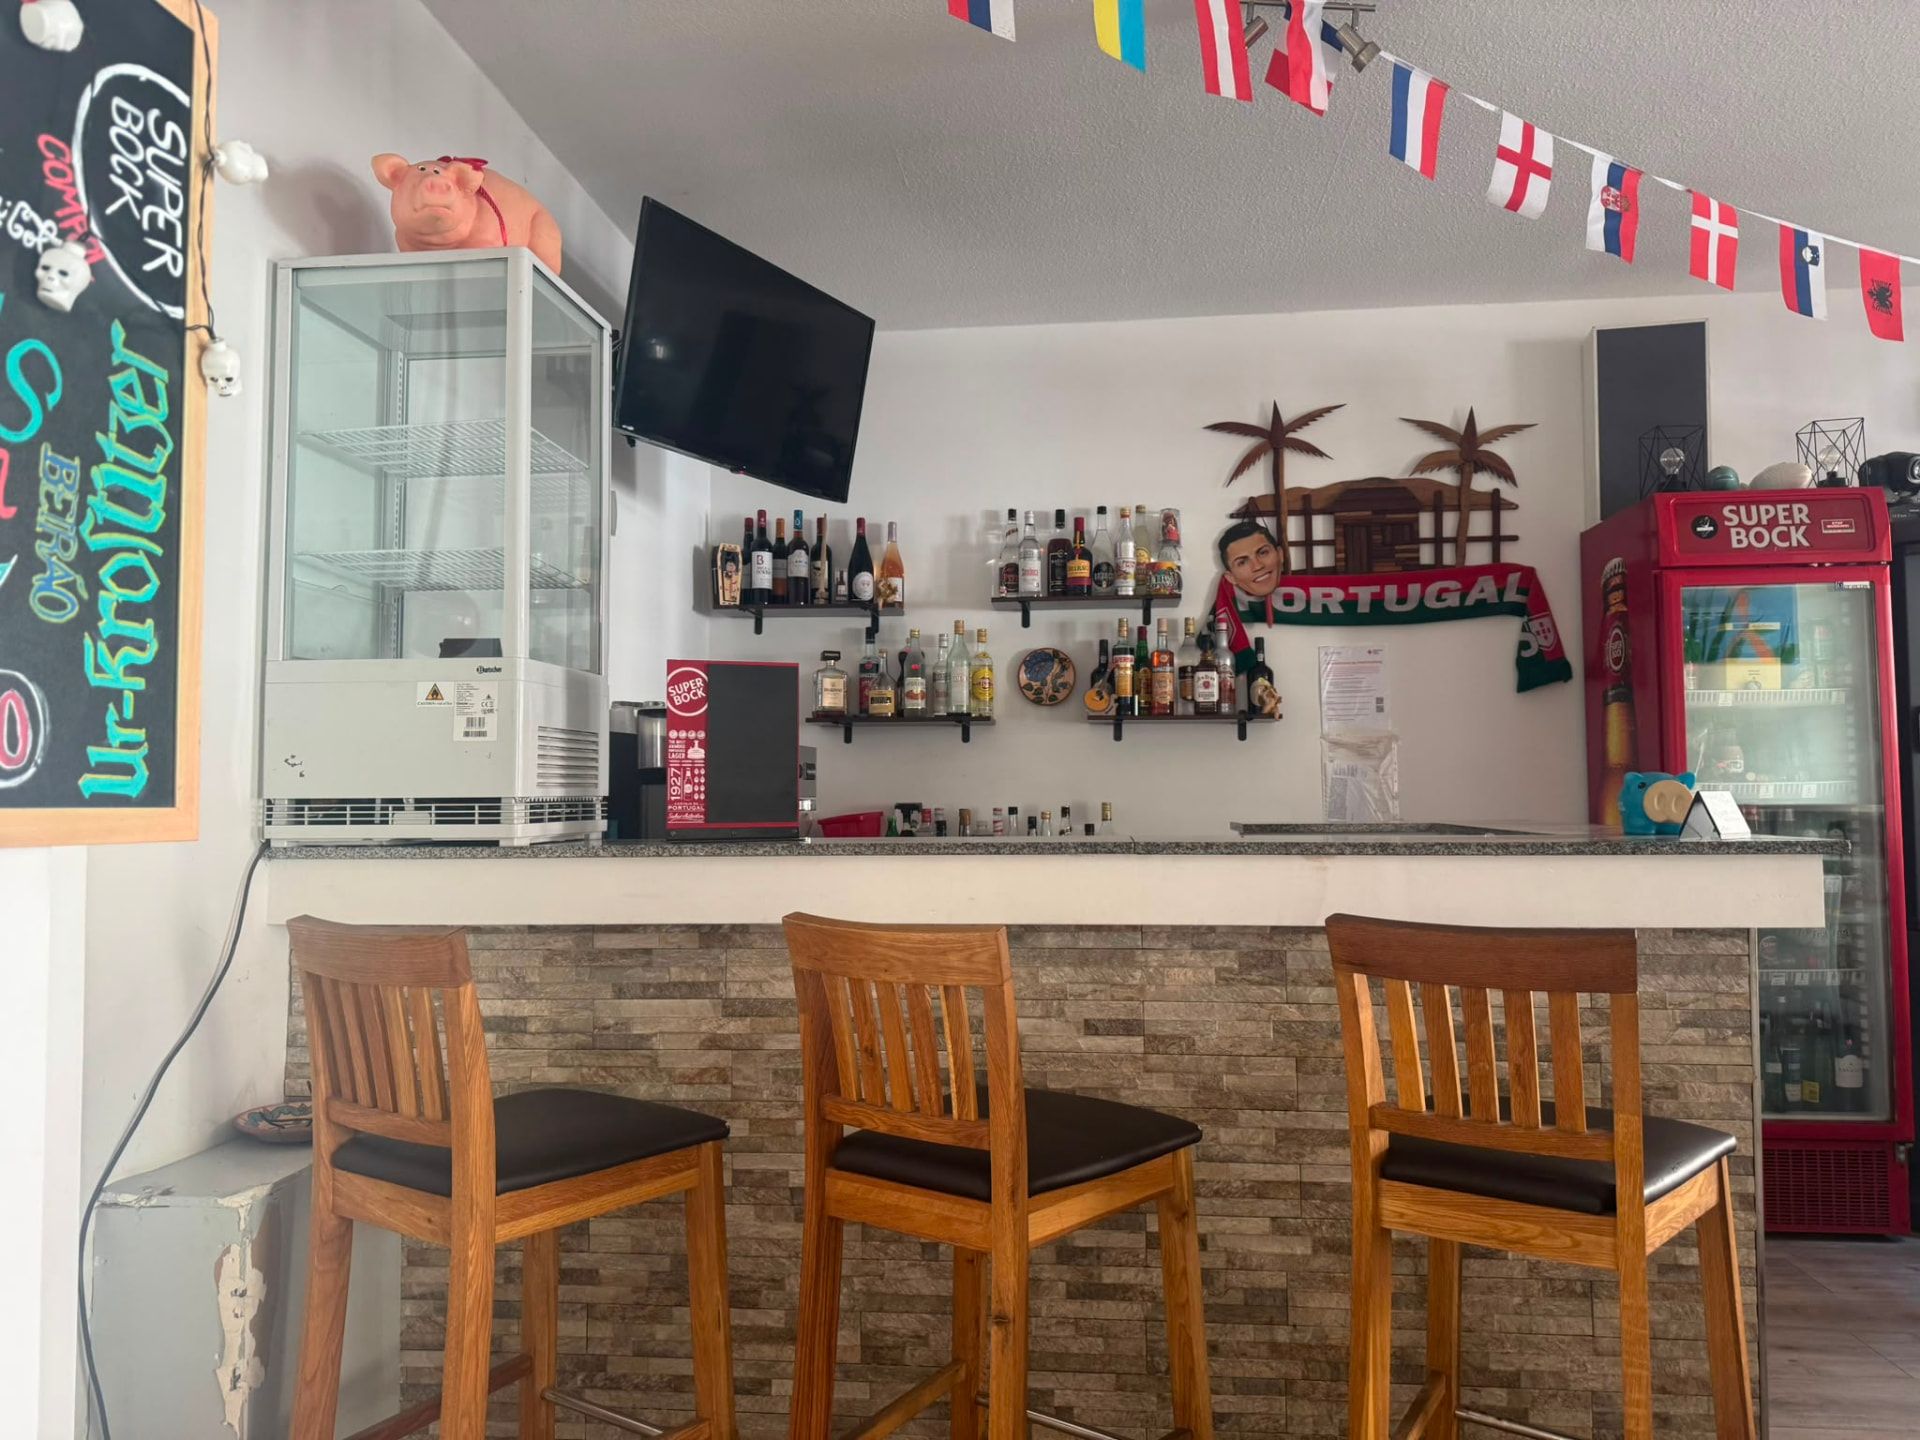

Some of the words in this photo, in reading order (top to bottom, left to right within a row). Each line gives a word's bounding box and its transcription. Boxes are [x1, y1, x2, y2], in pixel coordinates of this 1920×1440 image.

[105, 96, 145, 220] BOCK
[142, 108, 187, 279] SUPER
[1722, 503, 1811, 527] SUPER
[1730, 524, 1811, 549] BOCK
[668, 677, 704, 697] SUPER
[673, 687, 706, 706] BOCK
[670, 767, 682, 800] 1927
